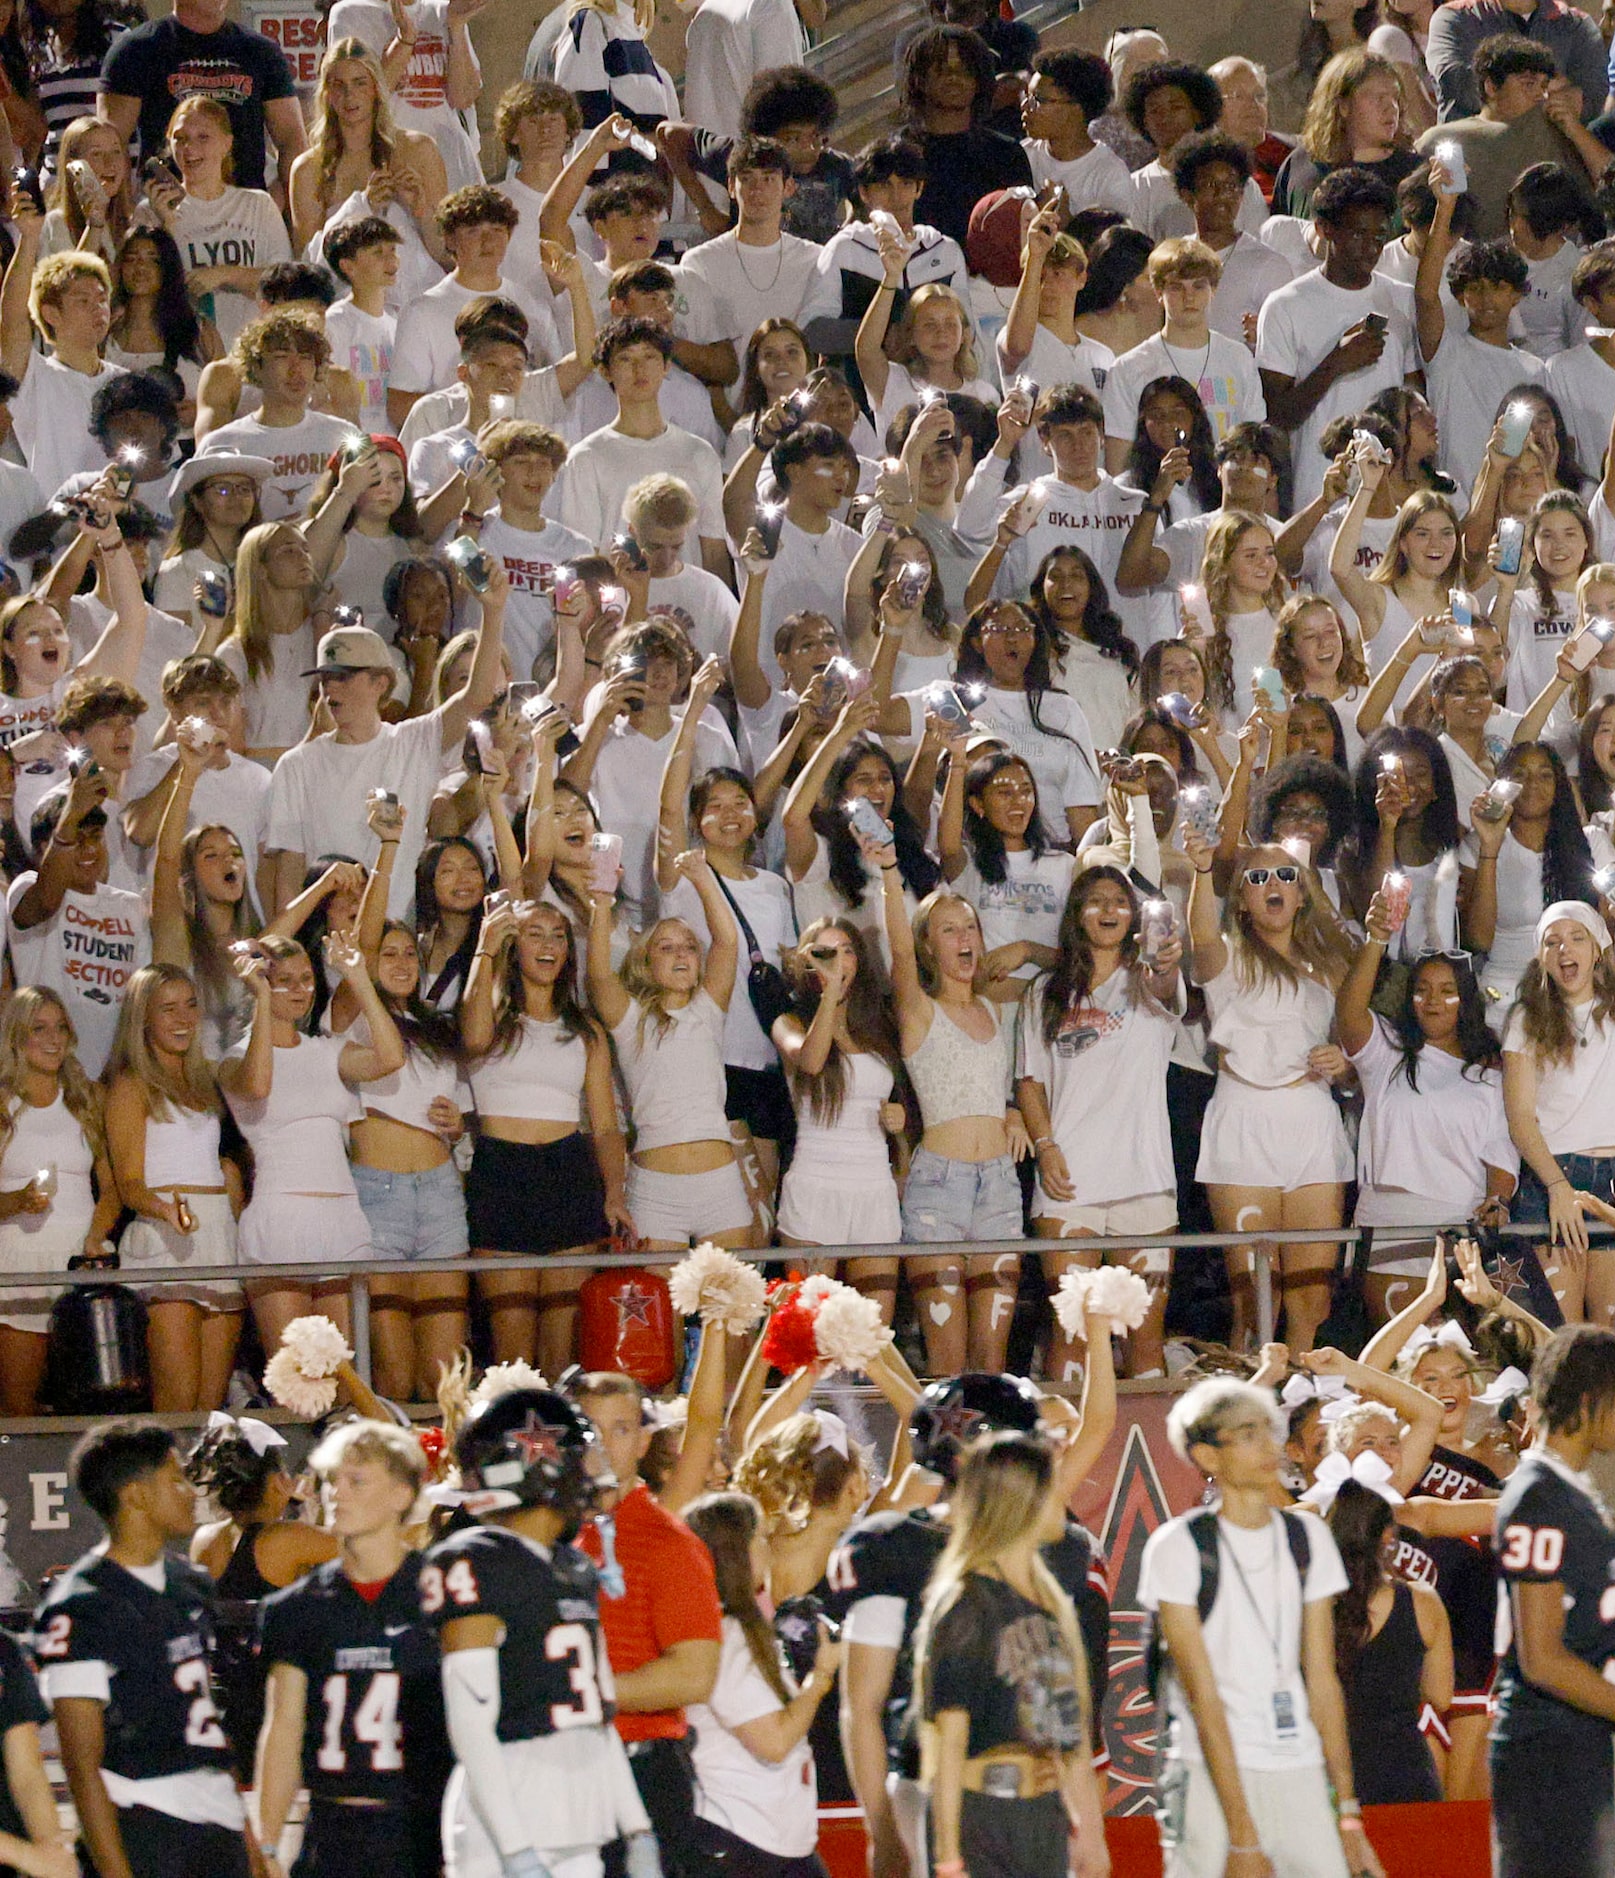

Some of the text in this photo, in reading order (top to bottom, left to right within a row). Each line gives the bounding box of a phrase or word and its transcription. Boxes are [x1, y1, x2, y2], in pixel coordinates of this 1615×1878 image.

[260, 18, 328, 48] RES
[188, 240, 255, 267] LYON
[64, 930, 135, 962] STUDENT
[29, 1472, 70, 1530] E
[1501, 1522, 1567, 1574] 30
[417, 1558, 480, 1614] 34
[38, 1614, 72, 1657] 2
[544, 1623, 618, 1728] 3
[317, 1671, 404, 1771] 14
